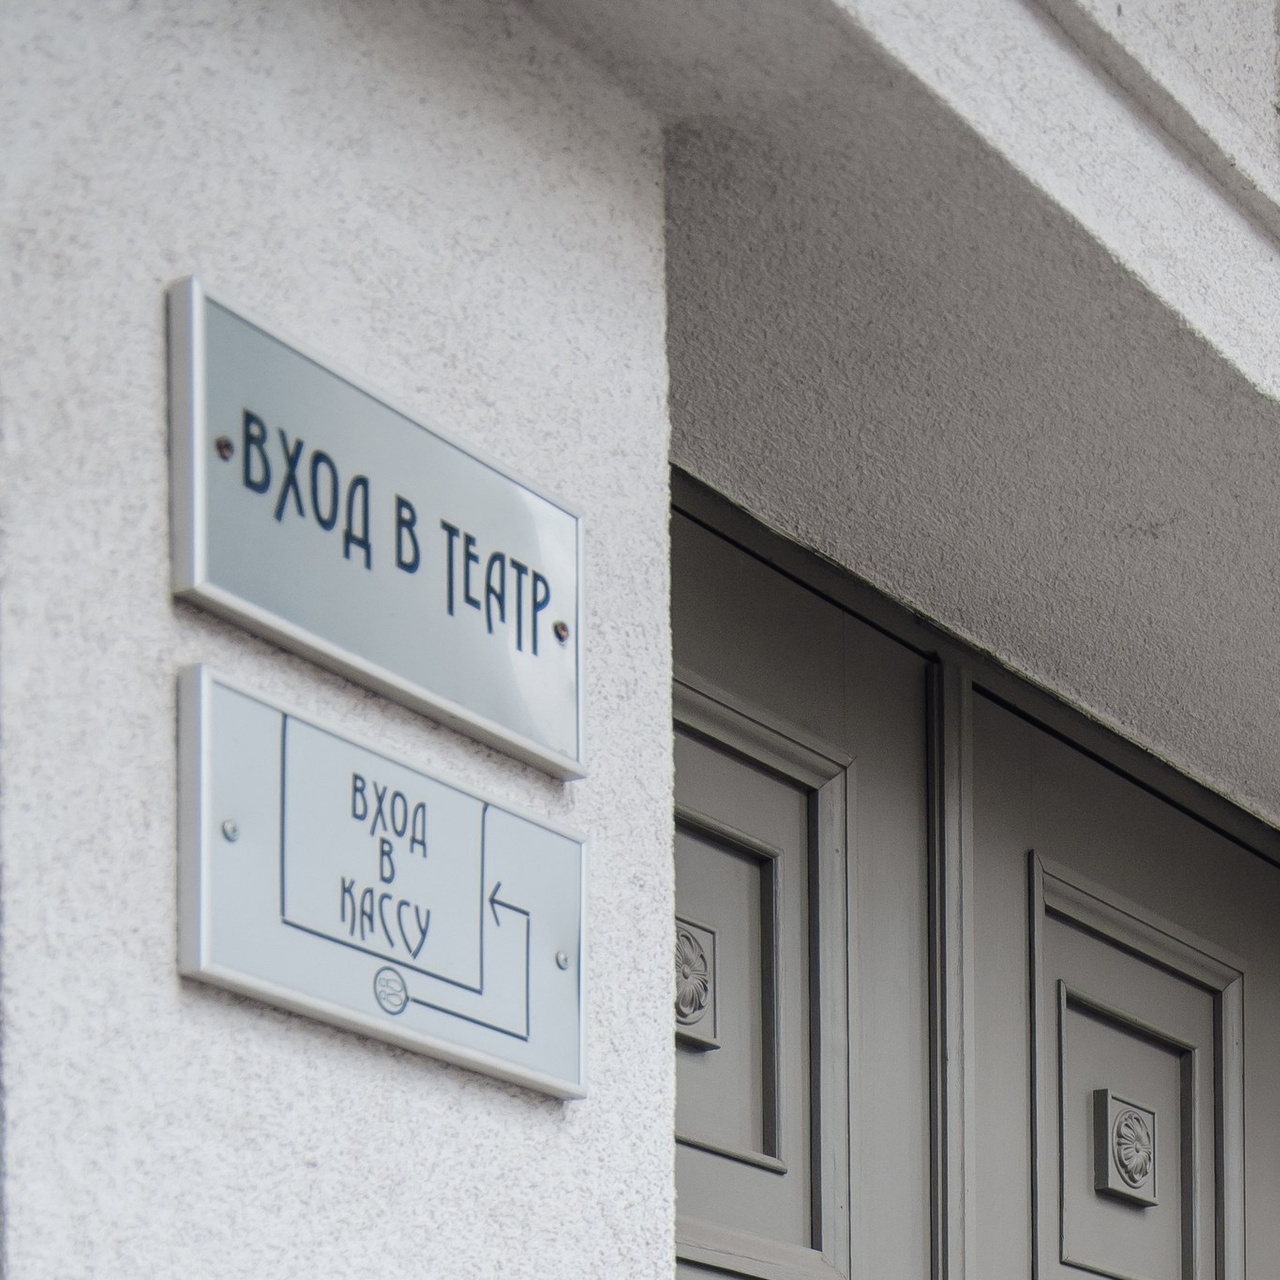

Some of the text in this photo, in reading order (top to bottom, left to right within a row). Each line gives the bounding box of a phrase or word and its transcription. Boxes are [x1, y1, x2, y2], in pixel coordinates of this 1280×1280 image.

[242, 408, 551, 657] ВХОД В ТЕАТР
[351, 772, 428, 859] ВХОД
[379, 836, 396, 885] В
[340, 876, 431, 960] КАССУ
